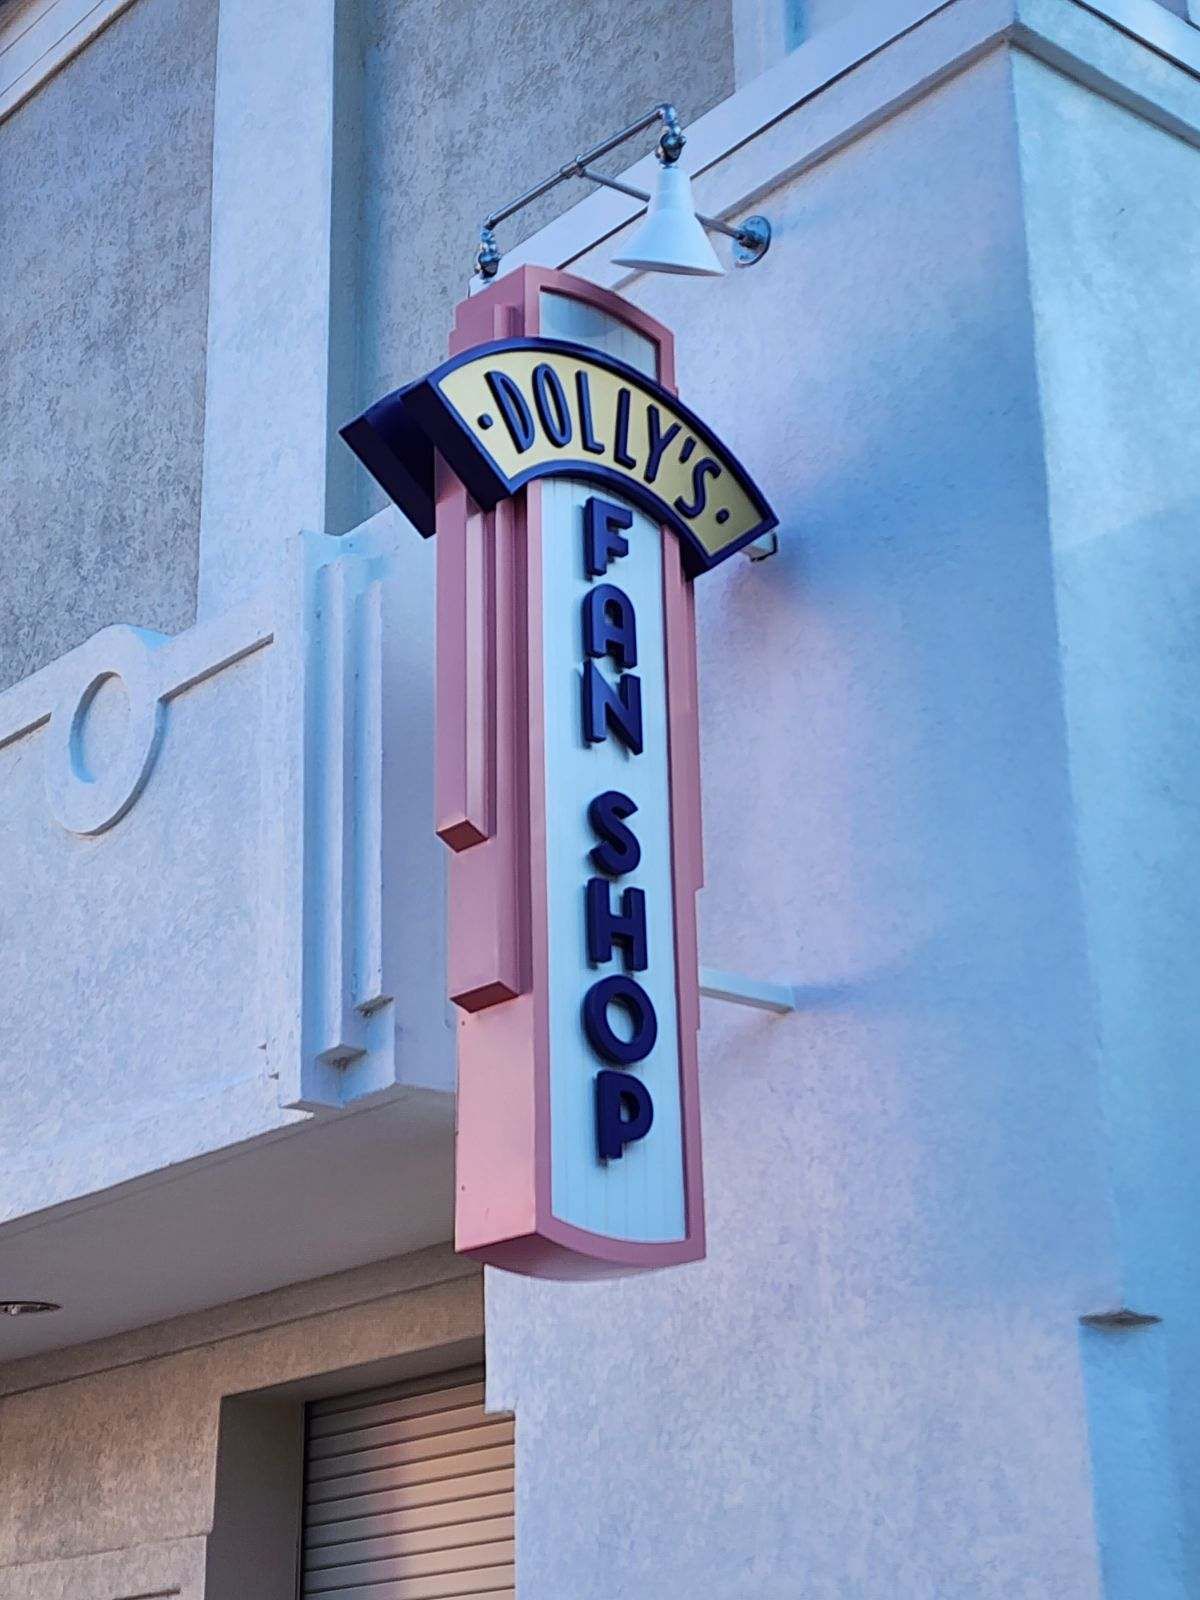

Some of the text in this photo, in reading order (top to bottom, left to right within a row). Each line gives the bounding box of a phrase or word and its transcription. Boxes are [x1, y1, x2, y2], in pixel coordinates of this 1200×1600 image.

[484, 363, 721, 519] DOLLY'S
[582, 496, 657, 1160] FAN SHOP
